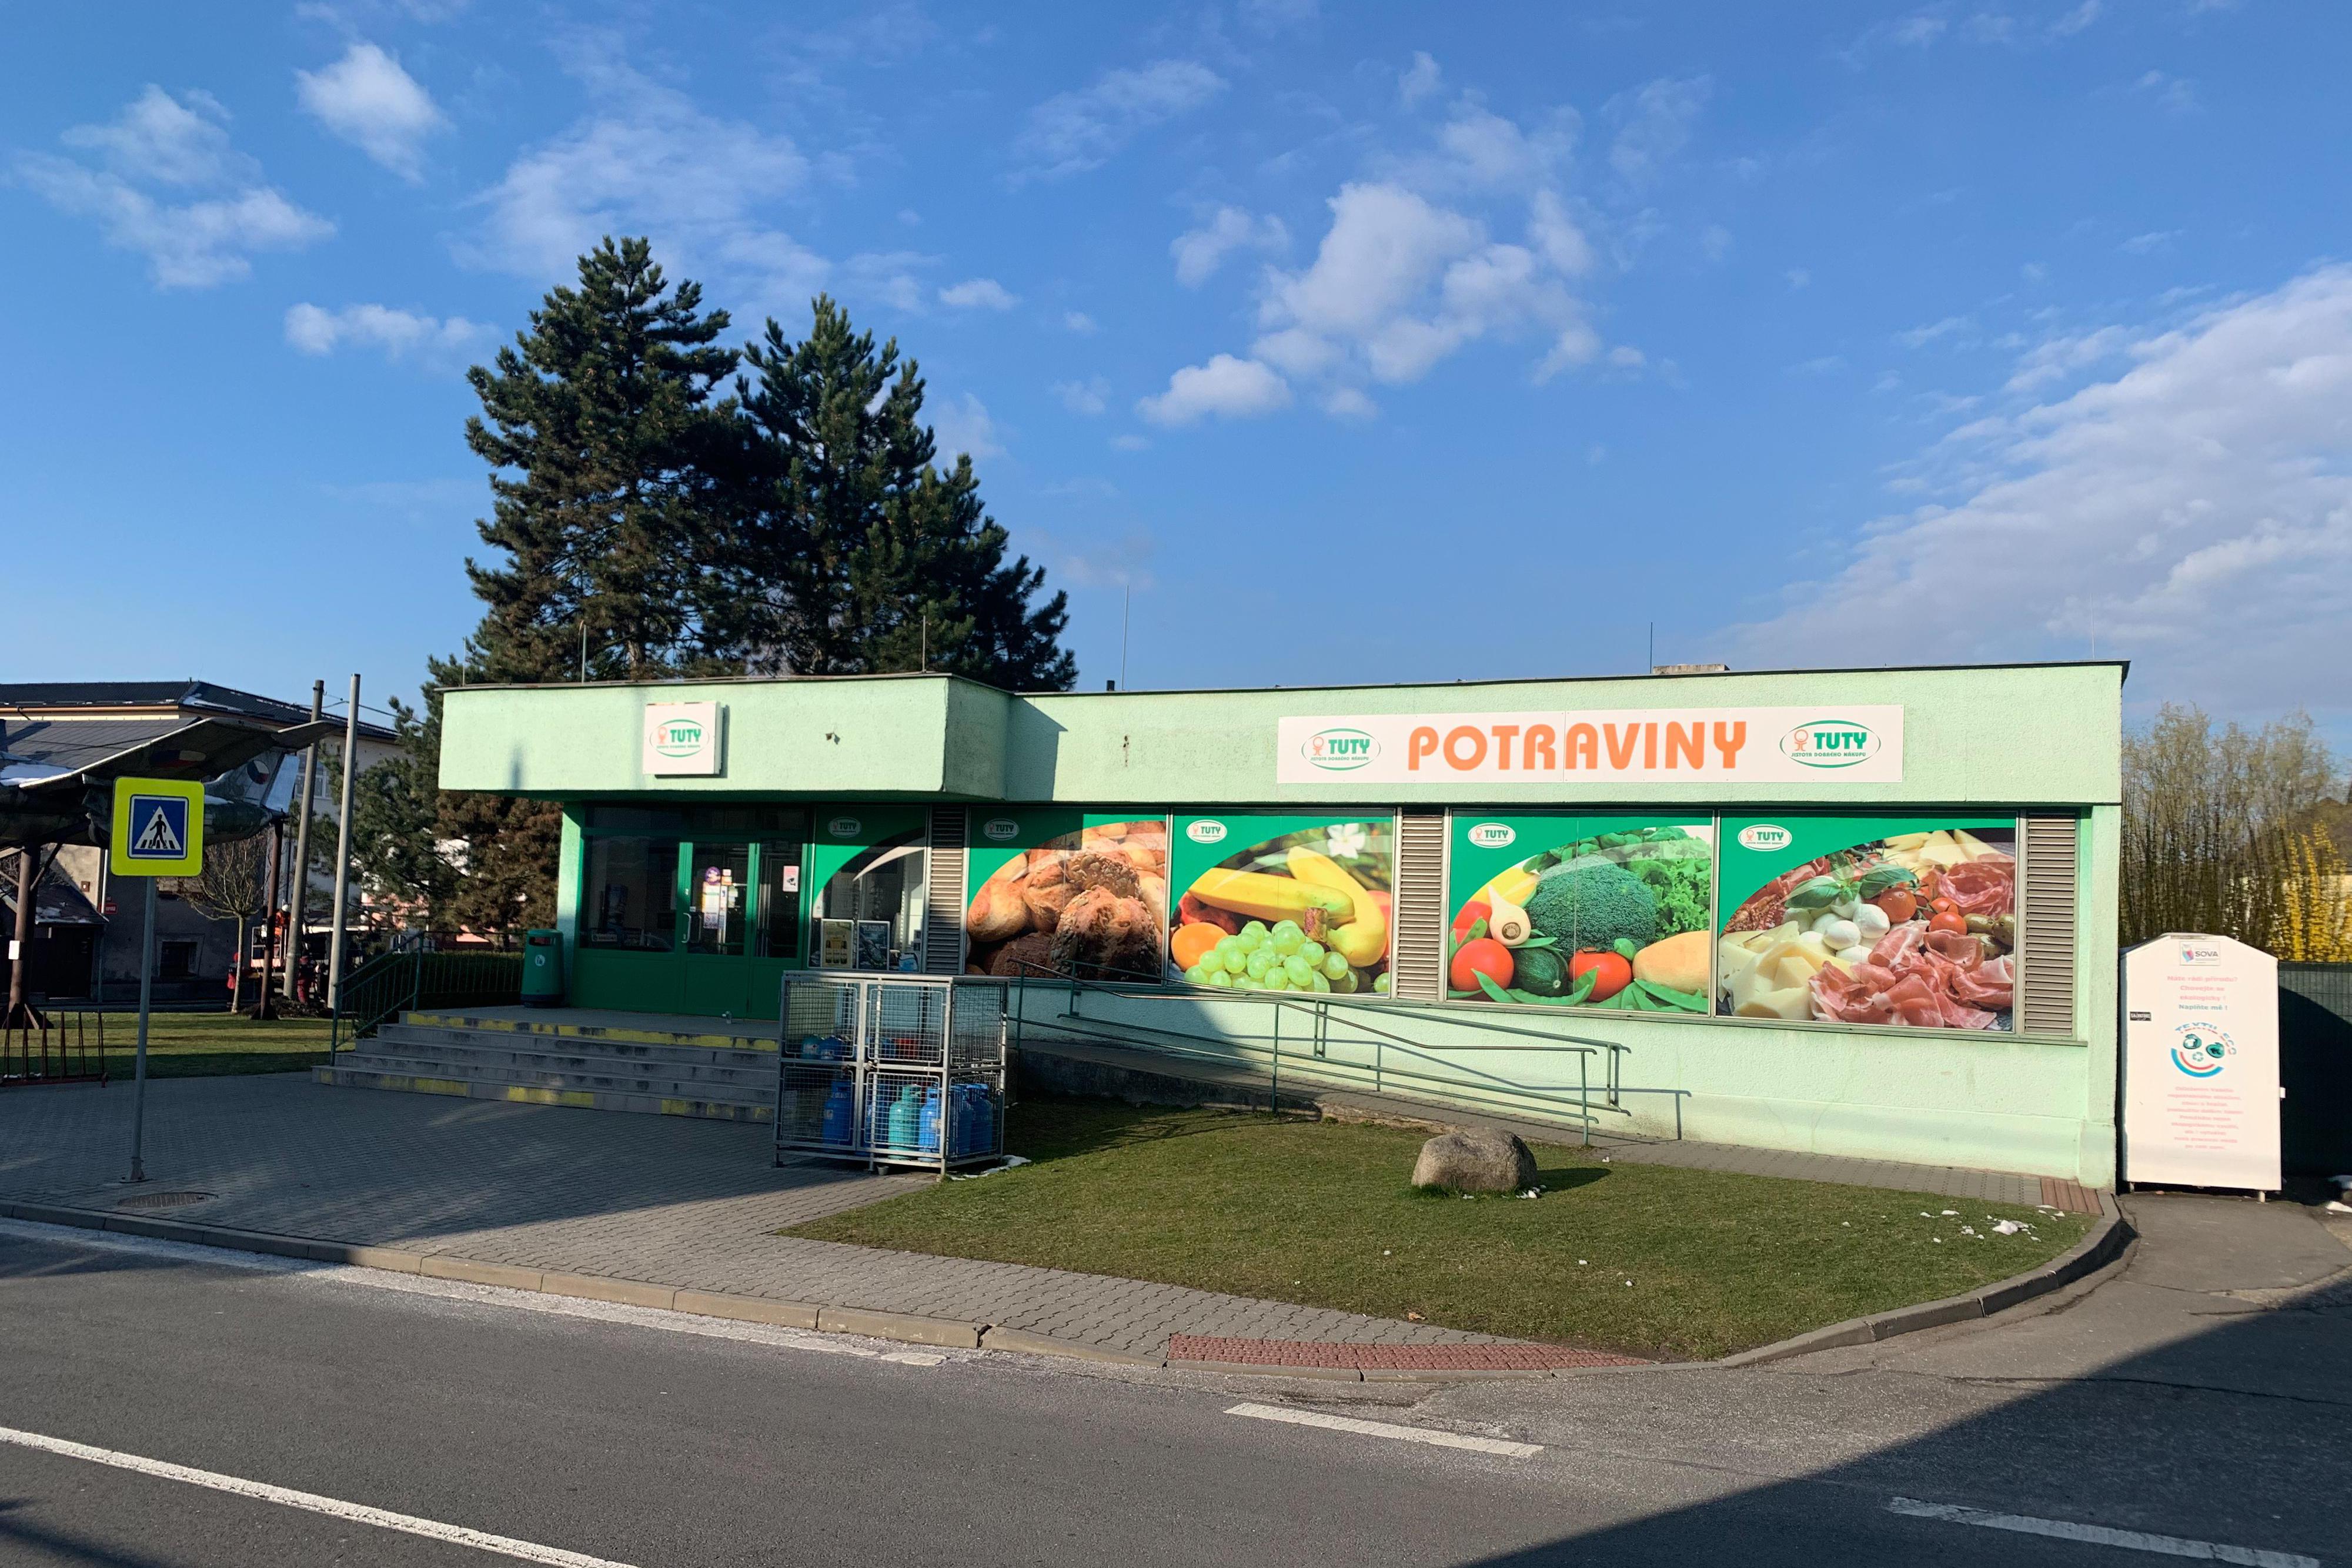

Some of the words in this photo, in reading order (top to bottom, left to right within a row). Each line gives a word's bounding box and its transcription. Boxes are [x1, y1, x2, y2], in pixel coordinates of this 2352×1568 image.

[670, 728, 701, 743] TUTY
[1813, 732, 1867, 750] TUTY
[1328, 738, 1370, 754] TUTY
[1408, 721, 1746, 771] POTRAVINY
[1485, 830, 1509, 838] TUTY
[1756, 831, 1784, 841] TUTY
